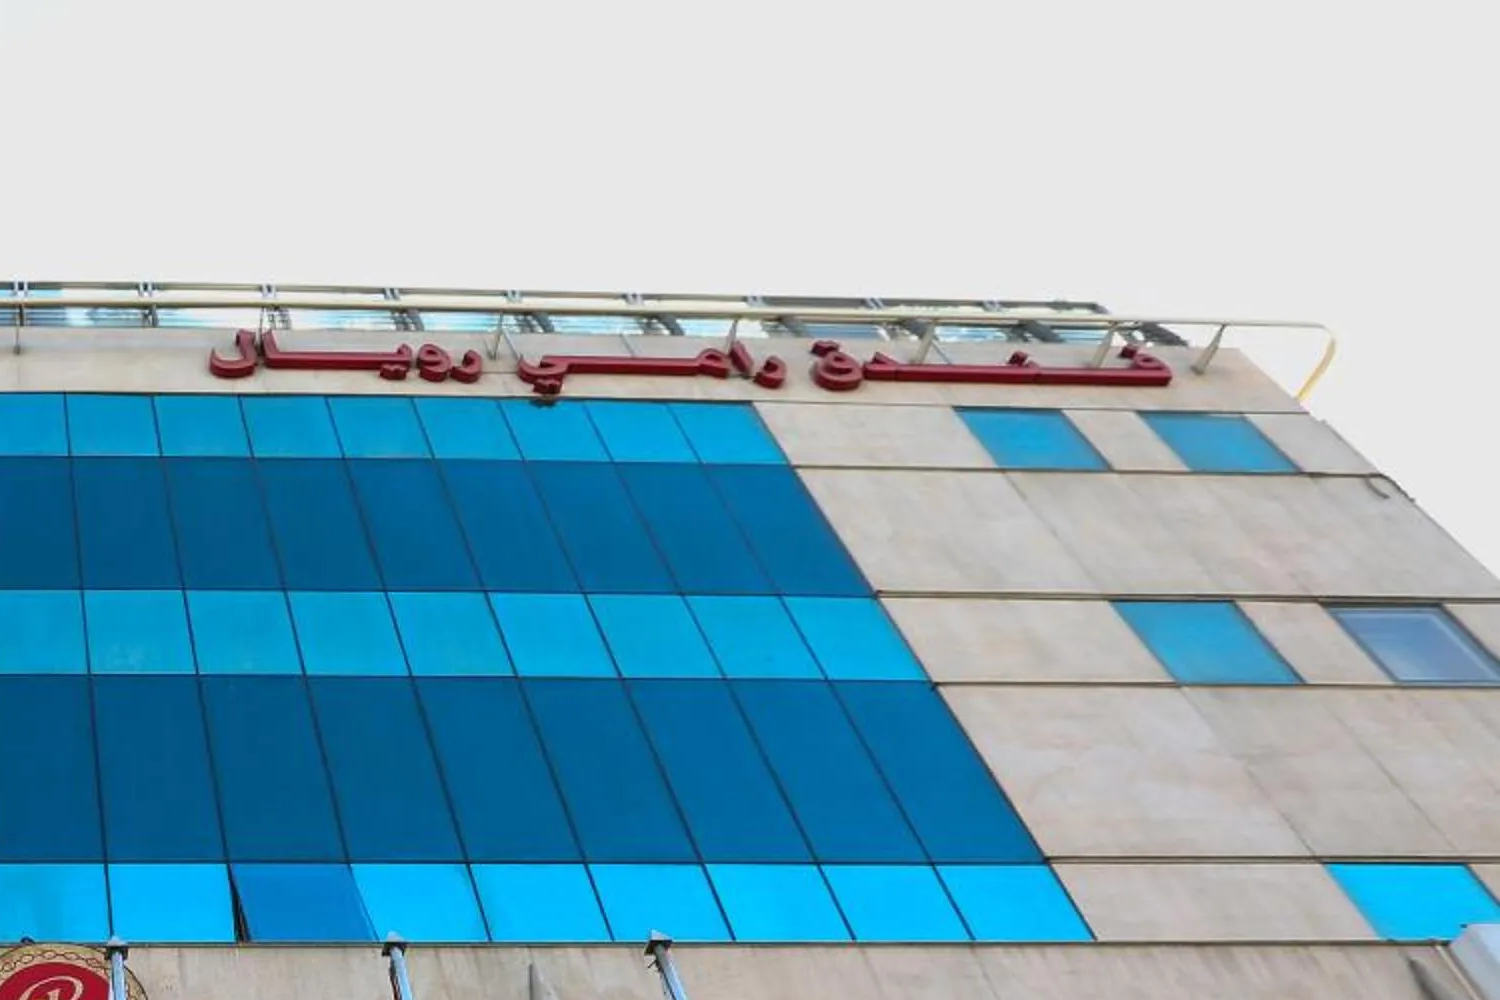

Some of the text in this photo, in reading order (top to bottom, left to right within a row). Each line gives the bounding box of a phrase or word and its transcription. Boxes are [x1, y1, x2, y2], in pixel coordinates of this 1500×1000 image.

[209, 329, 1173, 395] فندق رامي رويال
